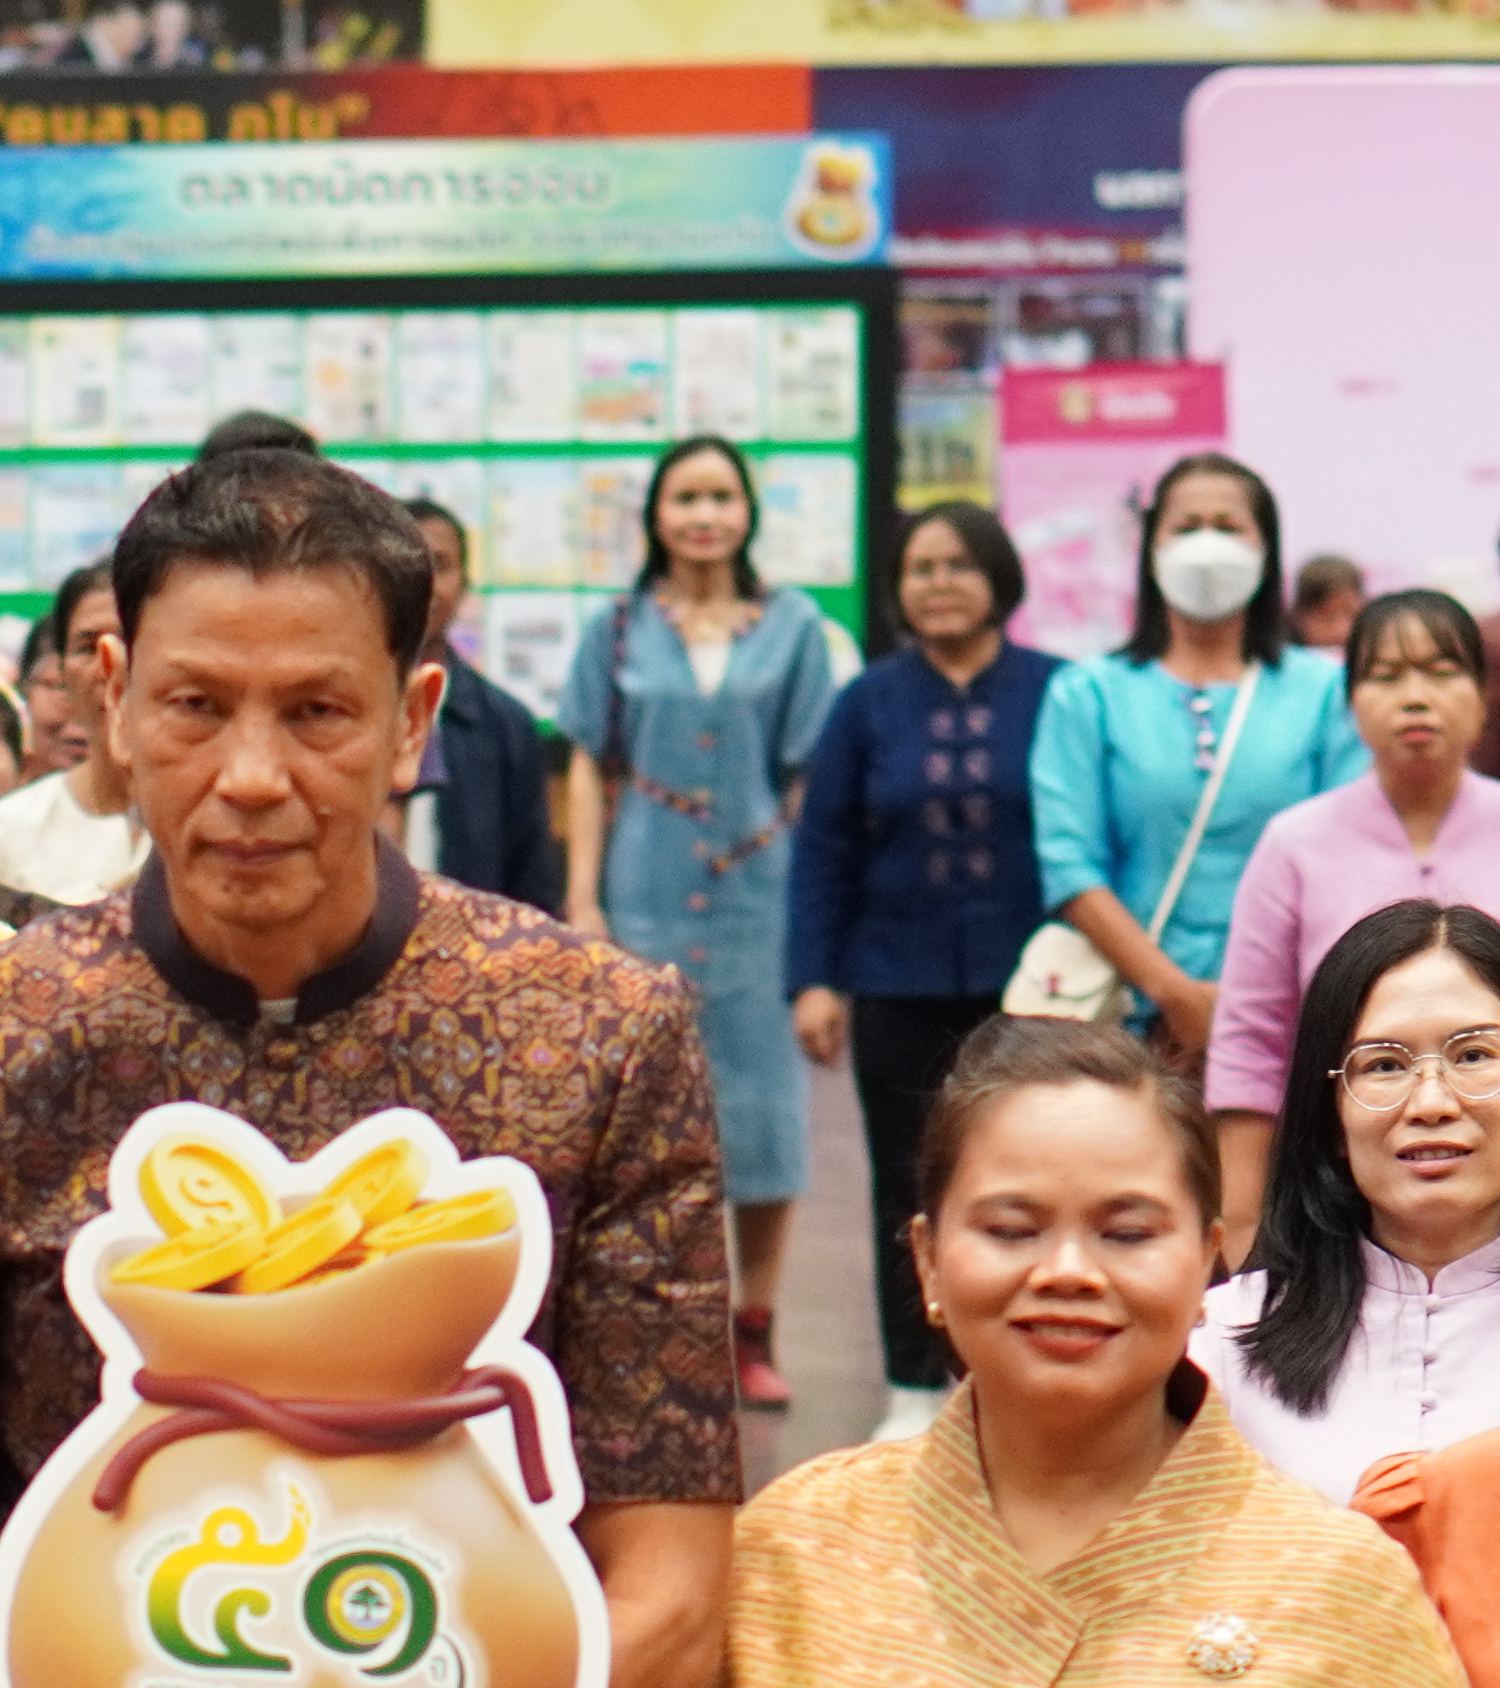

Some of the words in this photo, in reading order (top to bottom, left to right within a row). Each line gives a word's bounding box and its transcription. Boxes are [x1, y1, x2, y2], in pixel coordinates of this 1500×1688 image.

[179, 163, 612, 210] ตลาดนัดการออม
